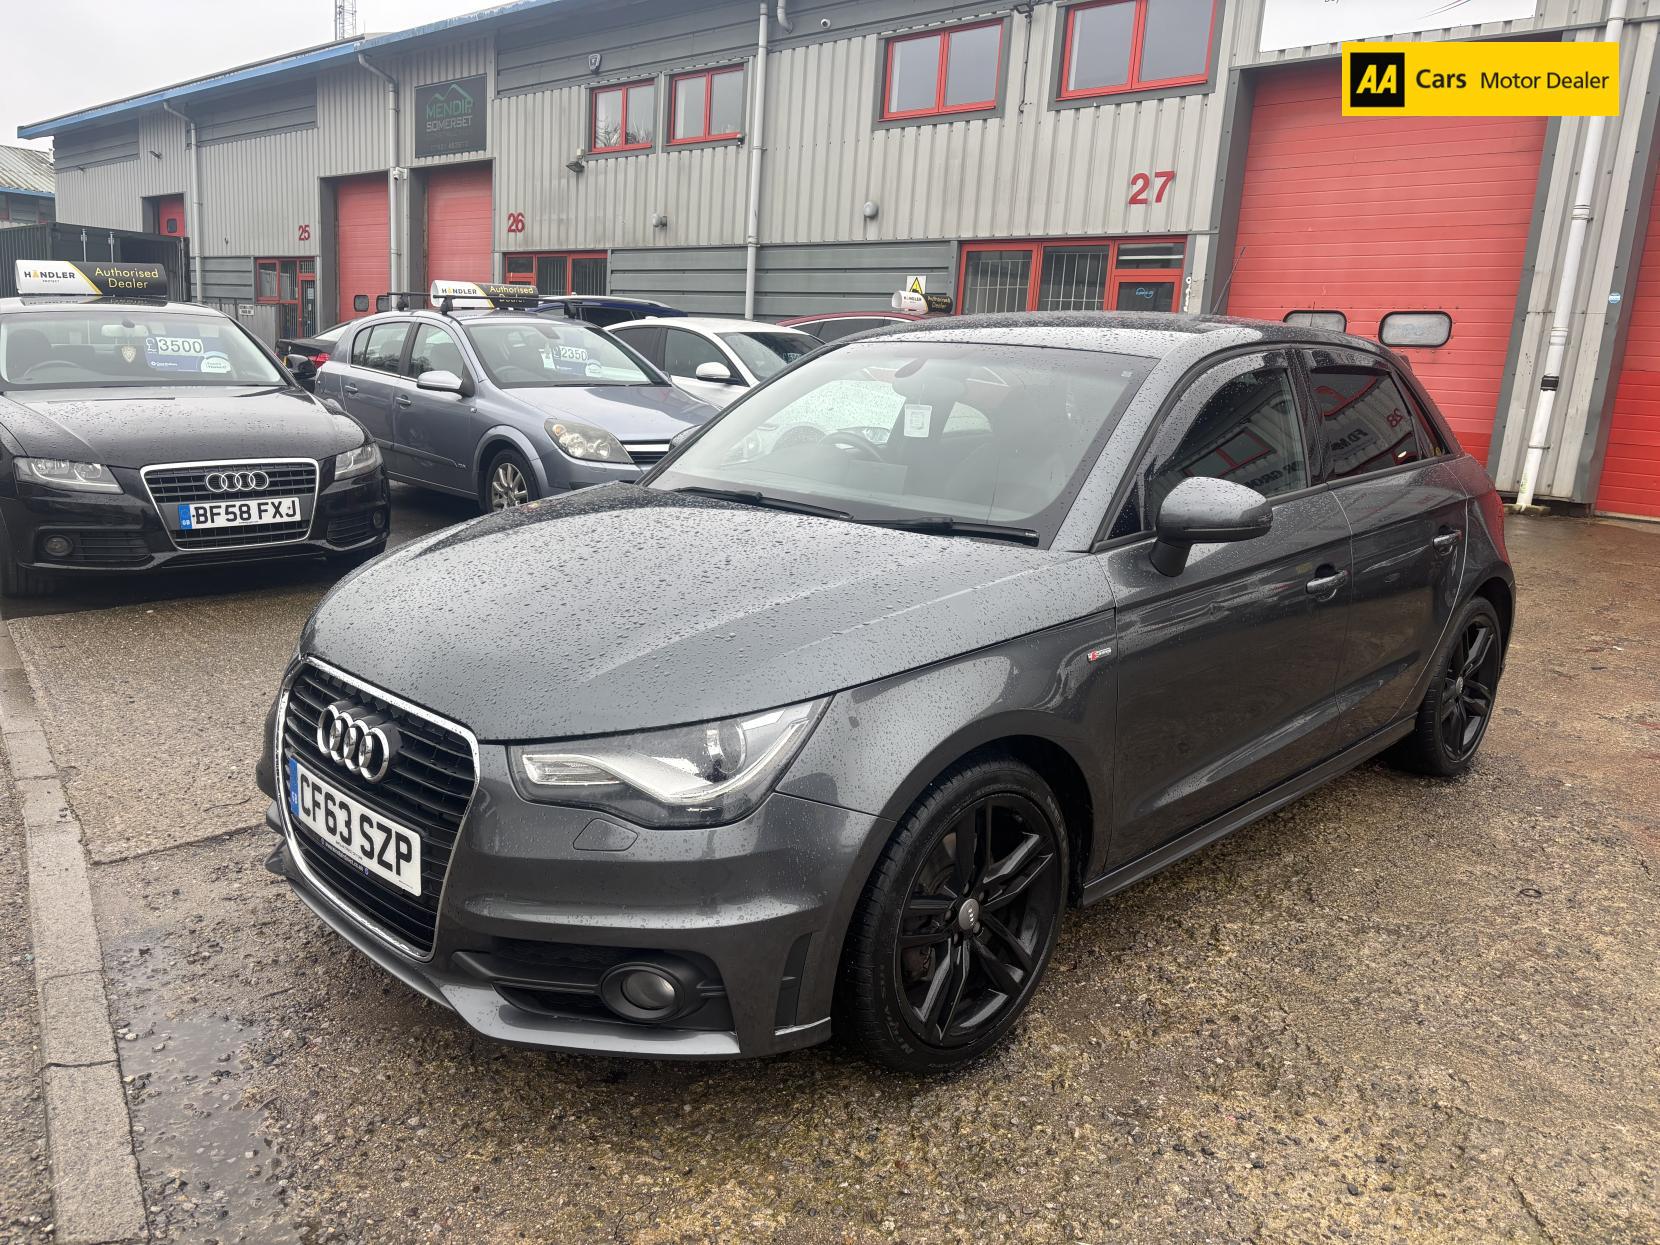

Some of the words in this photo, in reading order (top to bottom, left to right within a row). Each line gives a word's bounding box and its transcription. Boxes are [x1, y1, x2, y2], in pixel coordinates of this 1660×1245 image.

[426, 98, 473, 120] MENDIP
[426, 115, 473, 132] SOMERSET
[1128, 170, 1177, 205] 27
[507, 212, 525, 233] 26
[298, 224, 311, 241] 25
[95, 267, 159, 278] Authorised
[108, 278, 149, 289] Dealer
[489, 285, 534, 294] Authorised
[194, 503, 252, 525] BF58
[257, 500, 297, 520] FXJ
[300, 773, 353, 847] CF63
[359, 813, 413, 877] SZP
